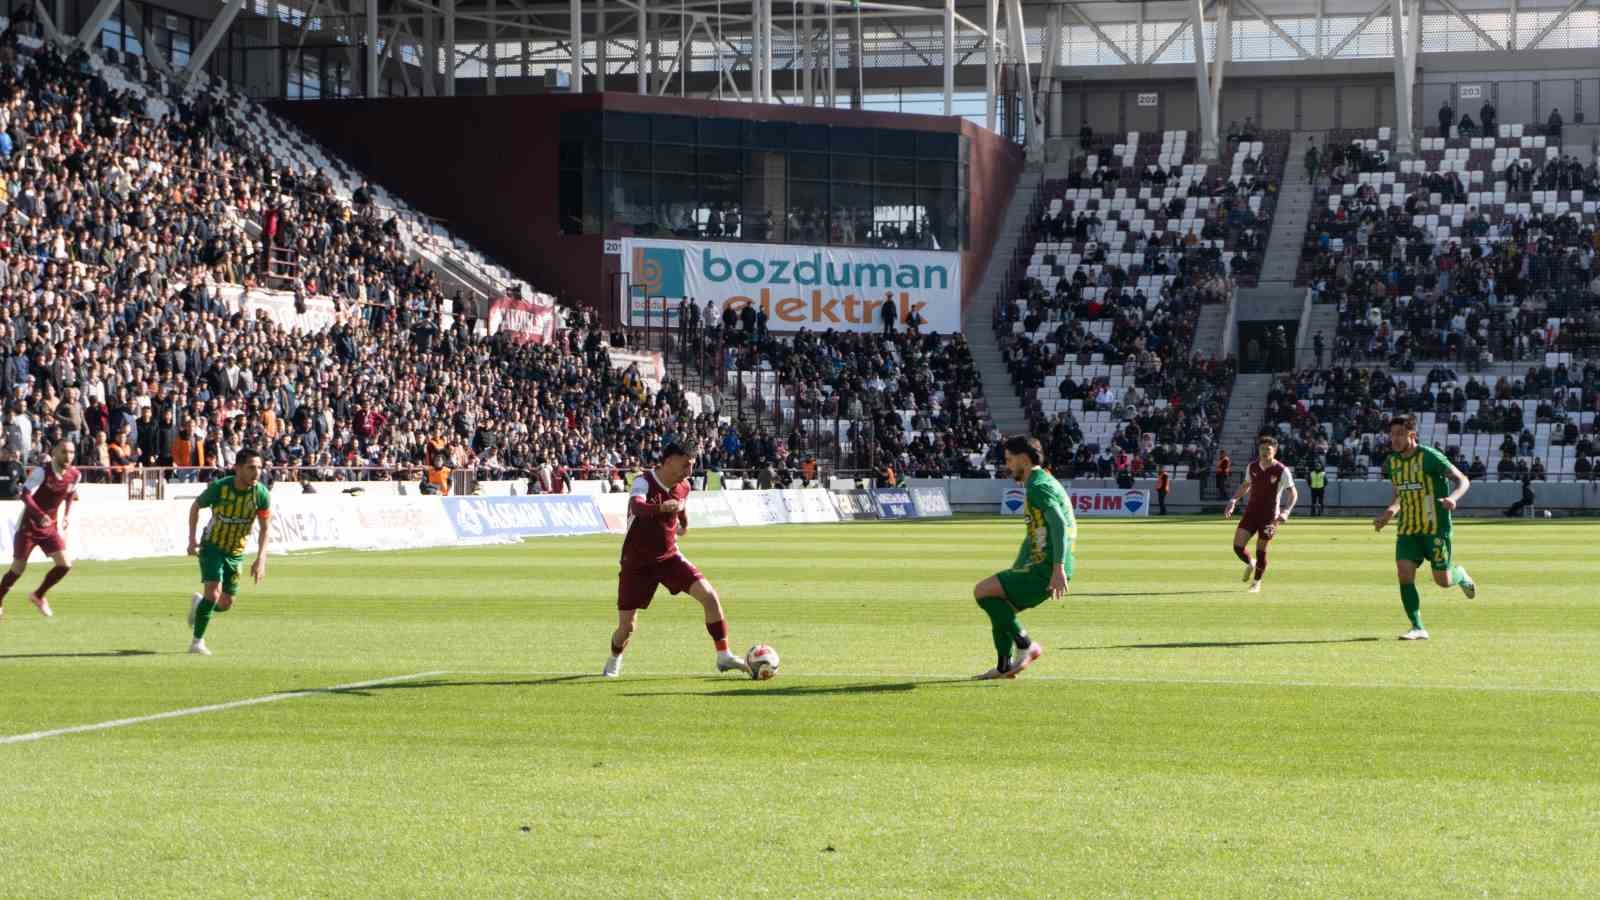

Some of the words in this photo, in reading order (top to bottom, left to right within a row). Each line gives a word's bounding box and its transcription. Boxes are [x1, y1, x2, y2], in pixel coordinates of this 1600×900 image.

[1140, 95, 1157, 104] 202
[1462, 87, 1480, 96] 203
[703, 249, 948, 289] bozduman
[723, 288, 929, 326] elektrk
